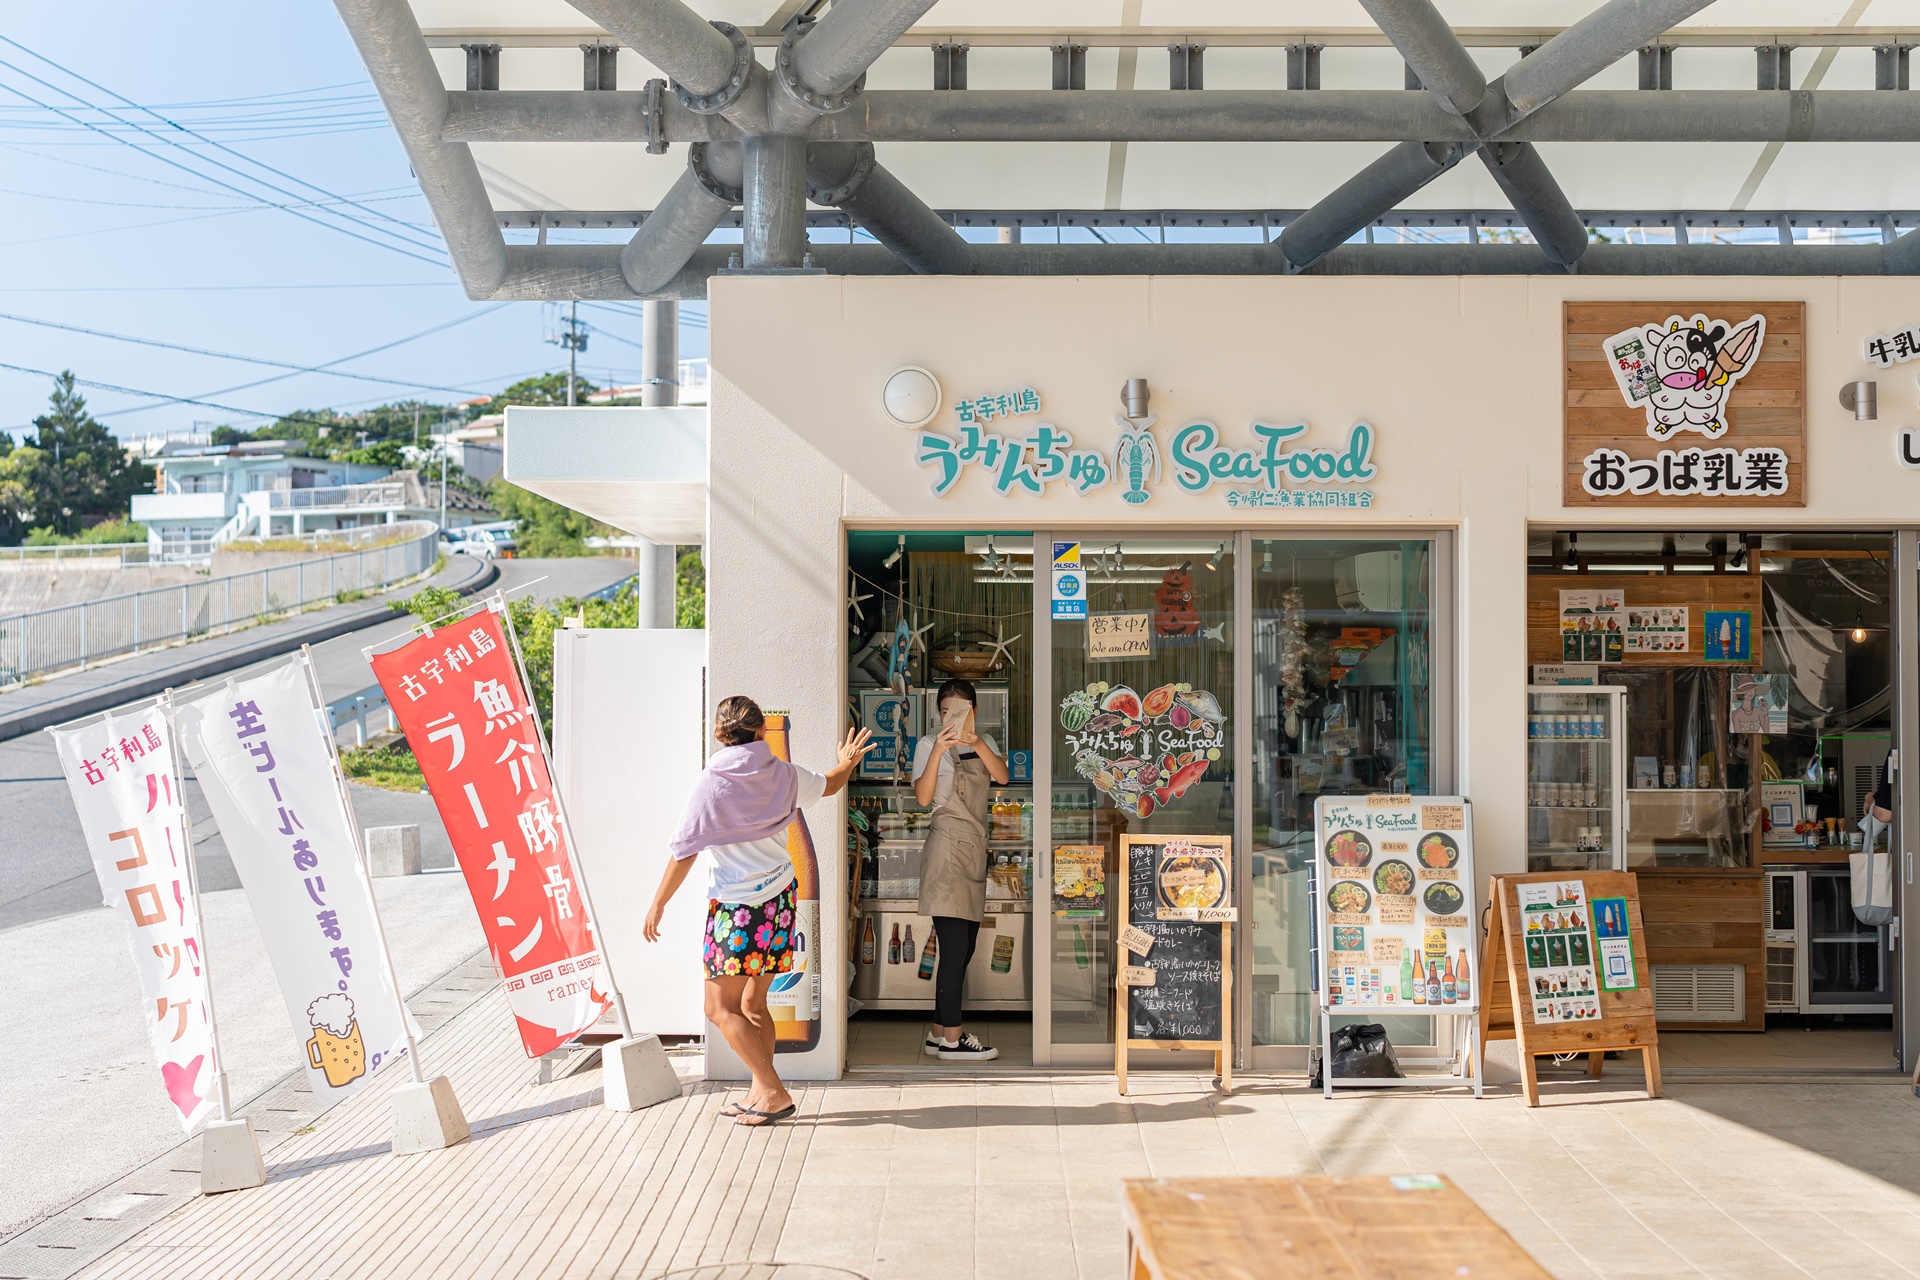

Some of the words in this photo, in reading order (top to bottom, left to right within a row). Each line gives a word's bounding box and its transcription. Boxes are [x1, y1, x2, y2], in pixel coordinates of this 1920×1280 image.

[955, 388, 1039, 422] 古宇利島
[920, 427, 1105, 492] うみんちゅ
[1172, 424, 1373, 491] SeaFood
[1588, 452, 1784, 491] おっぱ乳業
[1226, 491, 1373, 508] 今帰仁漁業協同組合
[1092, 617, 1147, 634] 営業中!
[1091, 641, 1106, 653] We
[1108, 644, 1122, 653] are
[1123, 639, 1148, 652] OPEN
[399, 627, 497, 702] 古宇利島
[80, 724, 162, 785] 古宇利島
[1065, 731, 1134, 756] うみんちゅ
[1158, 730, 1224, 752] SeaFood
[473, 676, 573, 919] 魚介豚骨
[1324, 814, 1363, 828] うみんちゅ
[1375, 813, 1418, 829] SeaFood
[426, 711, 543, 963] ラーメン
[1334, 868, 1367, 876] 生まぐろ丼
[1198, 910, 1231, 920] ¥1,000
[108, 827, 192, 1043] コロッケ
[1168, 971, 1221, 982] ソース焼きそば
[1144, 1000, 1194, 1012] 塩焼きそば
